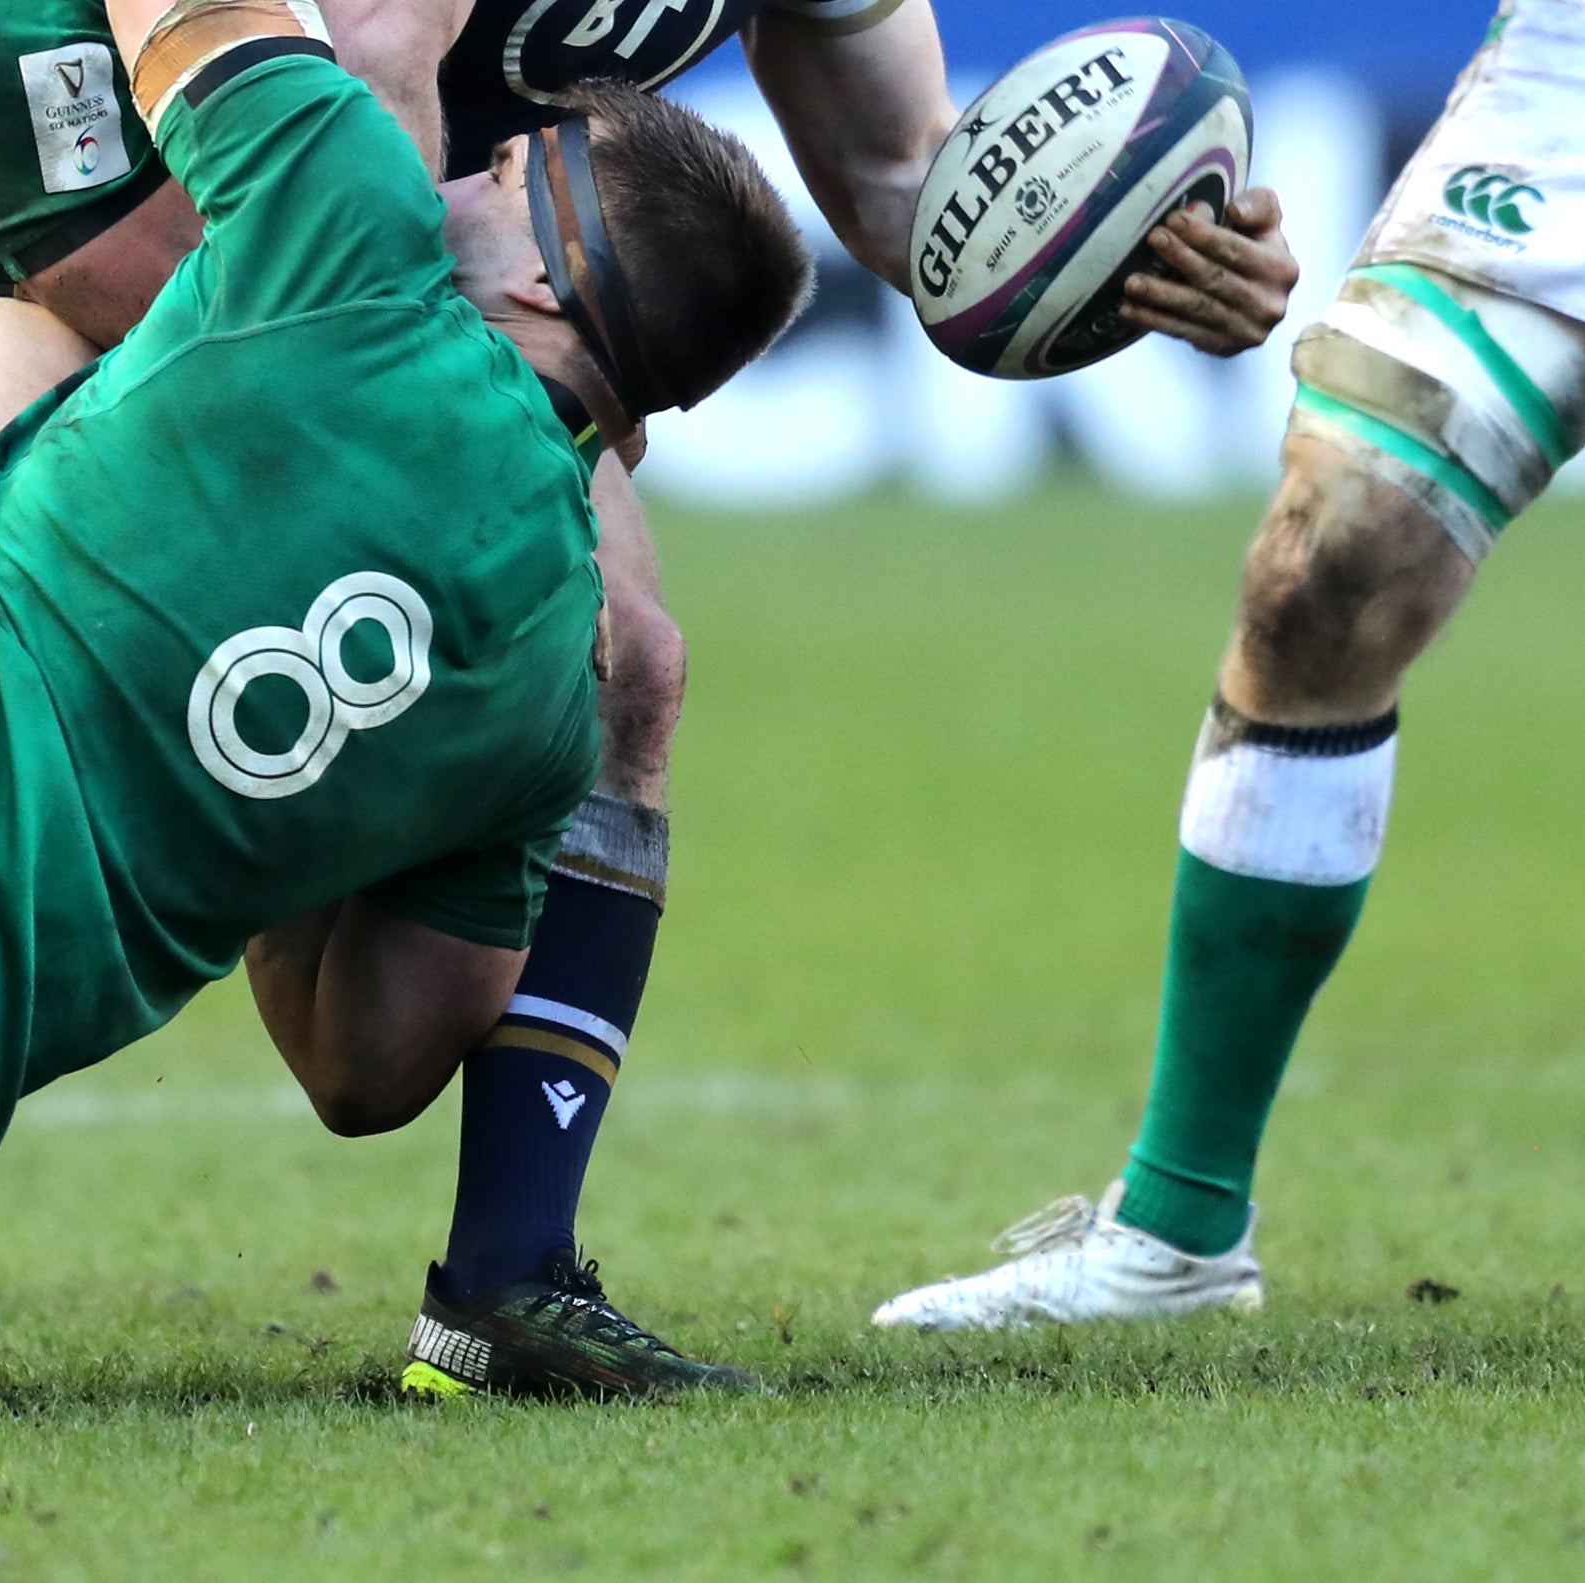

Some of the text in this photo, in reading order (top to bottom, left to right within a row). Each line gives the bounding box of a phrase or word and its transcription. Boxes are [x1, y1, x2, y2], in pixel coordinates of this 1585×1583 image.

[46, 94, 105, 119] GUINNESS
[49, 109, 109, 132] SIX NATIONS
[919, 46, 1134, 298] GILBERT
[186, 570, 433, 800] 8
